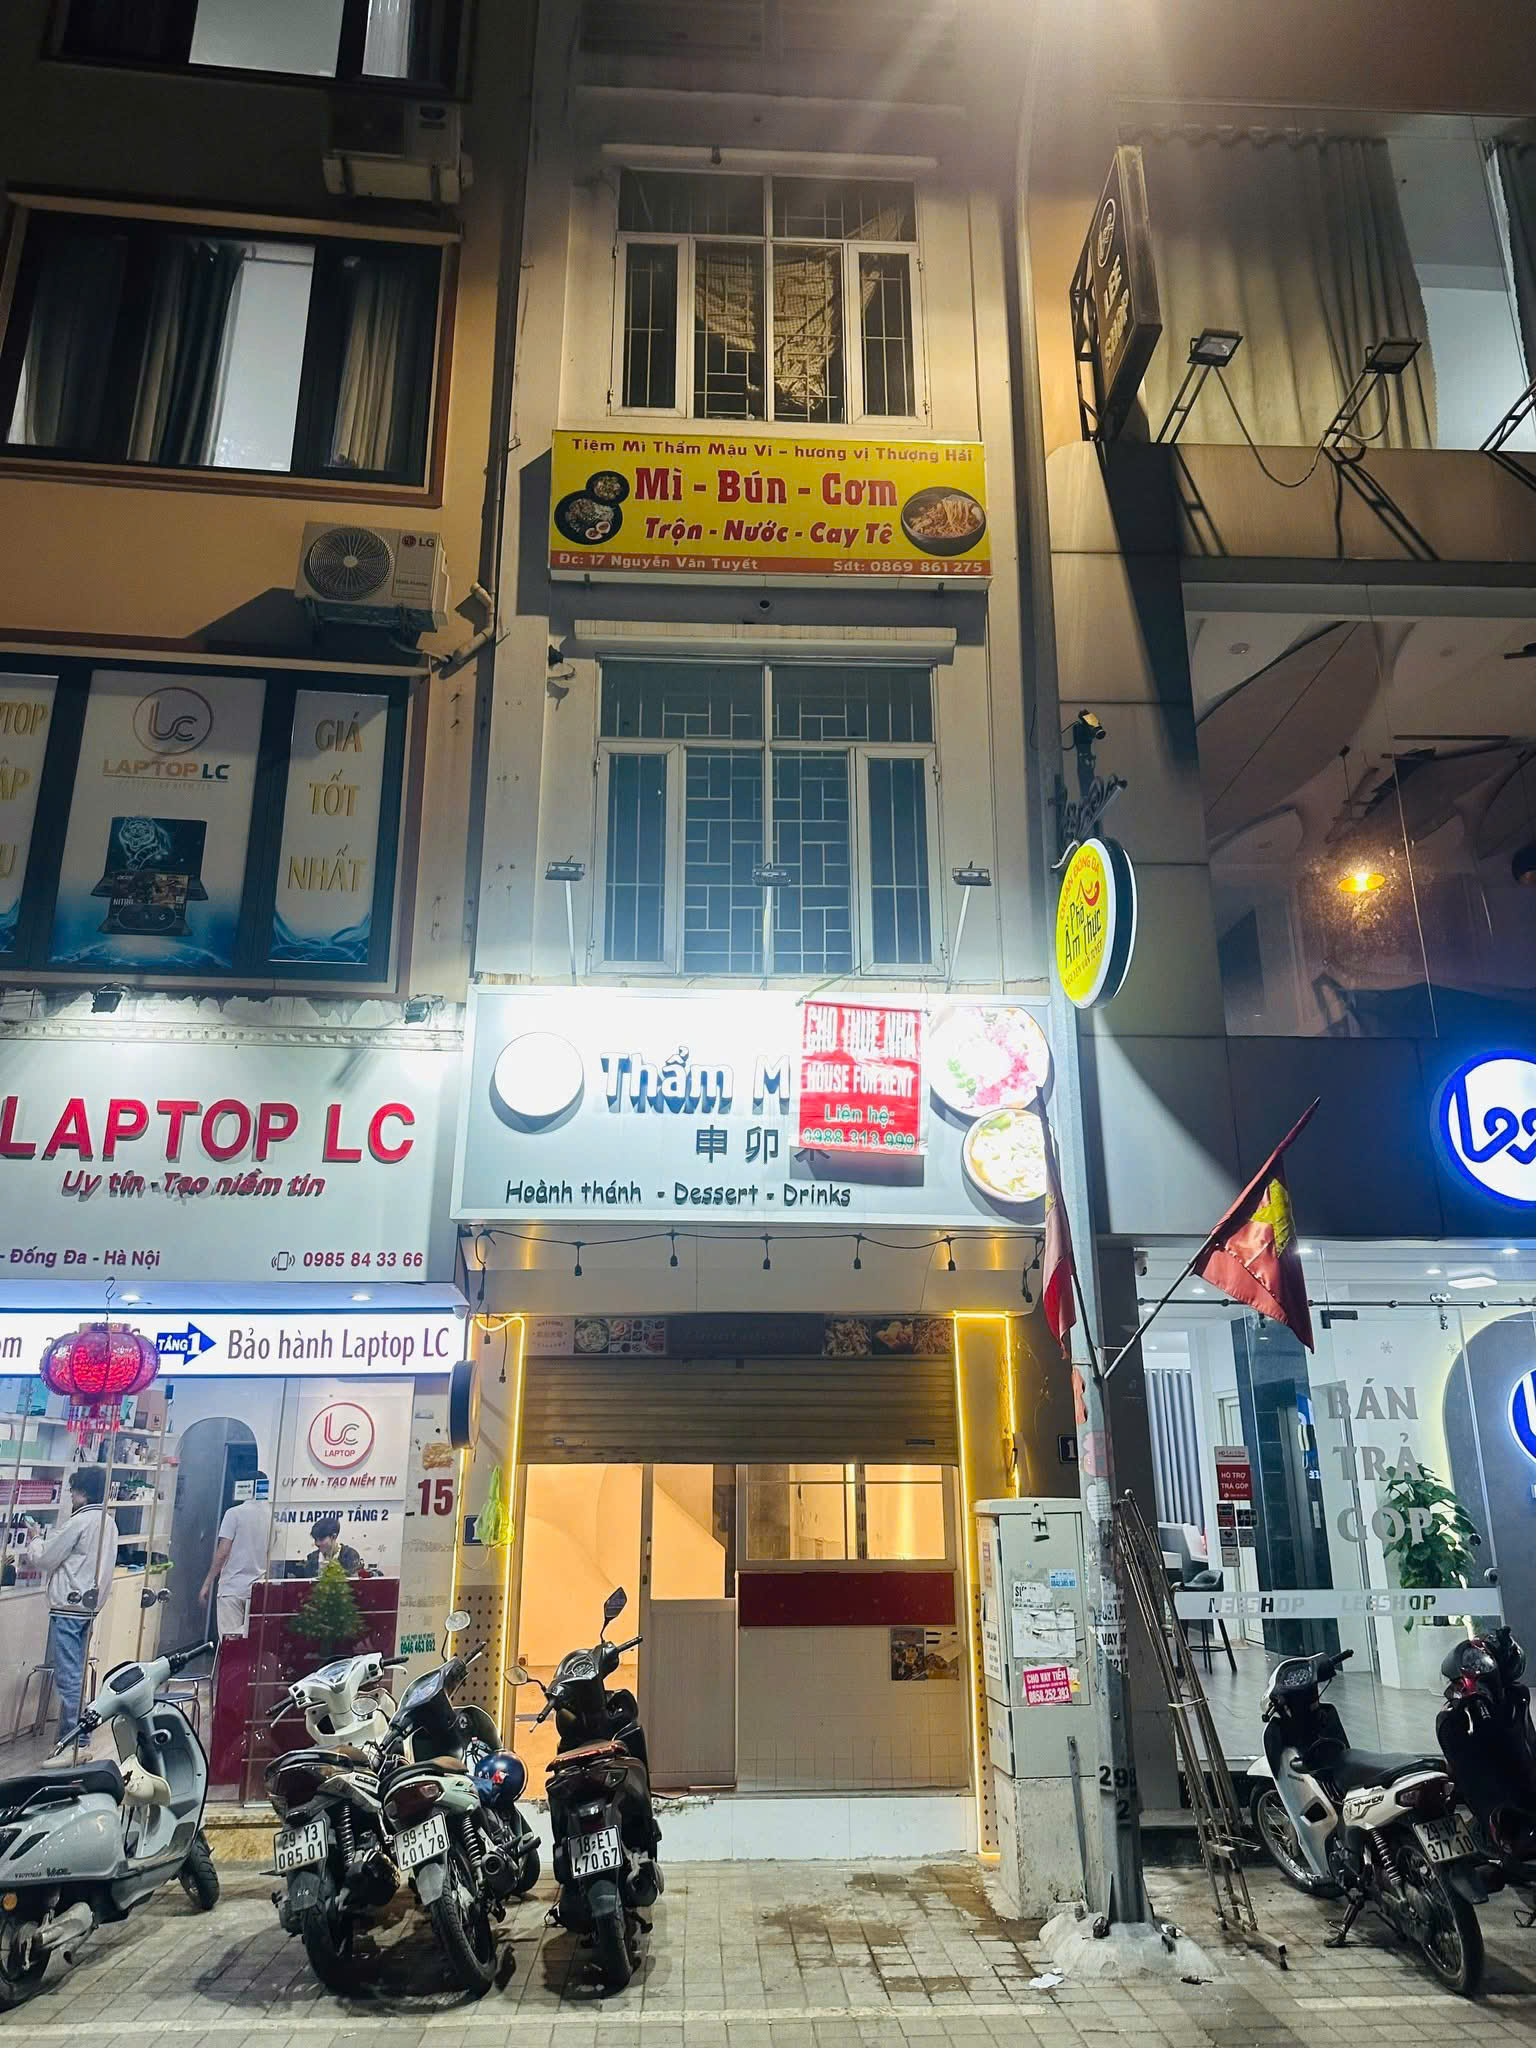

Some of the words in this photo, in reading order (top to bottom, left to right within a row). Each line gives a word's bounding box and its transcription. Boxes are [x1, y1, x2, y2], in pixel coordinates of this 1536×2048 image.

[795, 446, 847, 462] hương
[634, 467, 683, 501] Mì
[717, 469, 787, 504] Bún
[822, 472, 897, 506] Cơm
[419, 537, 435, 548] LG
[645, 516, 703, 547] Trộn
[723, 518, 789, 543] Nước
[810, 522, 859, 549] Cay
[866, 523, 894, 545] Tê
[589, 554, 605, 566] 17
[870, 561, 913, 573] 0869
[920, 562, 949, 573] 861
[953, 562, 983, 573] 275
[315, 712, 363, 752] GIÁ
[103, 758, 198, 777] LAPTOP
[202, 763, 231, 780] LC
[308, 769, 360, 817] TỐT
[287, 844, 368, 892] NHẤT
[600, 1046, 734, 1112] Thẩm
[806, 1063, 850, 1094] HOUSE
[824, 1103, 862, 1123] Liên
[0, 1096, 299, 1162] LAPTOP
[323, 1103, 416, 1163] LC
[62, 1170, 102, 1202] Uy
[506, 1179, 573, 1204] Hoành
[581, 1180, 642, 1205] thánh
[674, 1182, 759, 1206] Dessert
[783, 1183, 851, 1206] Drinks
[10, 1247, 57, 1267] Đống
[64, 1250, 87, 1265] Đa
[104, 1249, 126, 1266] Hà
[131, 1250, 161, 1270] Nội
[303, 1252, 345, 1267] 0985
[350, 1252, 372, 1267] 84
[376, 1252, 397, 1267] 33
[402, 1252, 424, 1267] 66
[228, 1327, 270, 1359] Bảo
[278, 1329, 333, 1359] hành
[342, 1328, 415, 1366] Laptop
[423, 1327, 449, 1358] LC
[1328, 1378, 1419, 1420] BÁN
[324, 1449, 355, 1458] LAPTOP
[1332, 1432, 1424, 1481] TRẢ
[282, 1477, 298, 1488] UY
[301, 1475, 318, 1487] TÍN
[418, 1479, 454, 1517] 15
[299, 1509, 344, 1523] LAPTOP
[381, 1509, 389, 1521] 2
[1026, 1673, 1040, 1684] CHO
[281, 1823, 319, 1850] 29-Y3
[402, 1819, 437, 1848] 99-F1
[577, 1830, 612, 1853] 18-E1
[278, 1840, 323, 1870] 085.01
[401, 1833, 446, 1867] 401.78
[574, 1847, 619, 1875] 470.67
